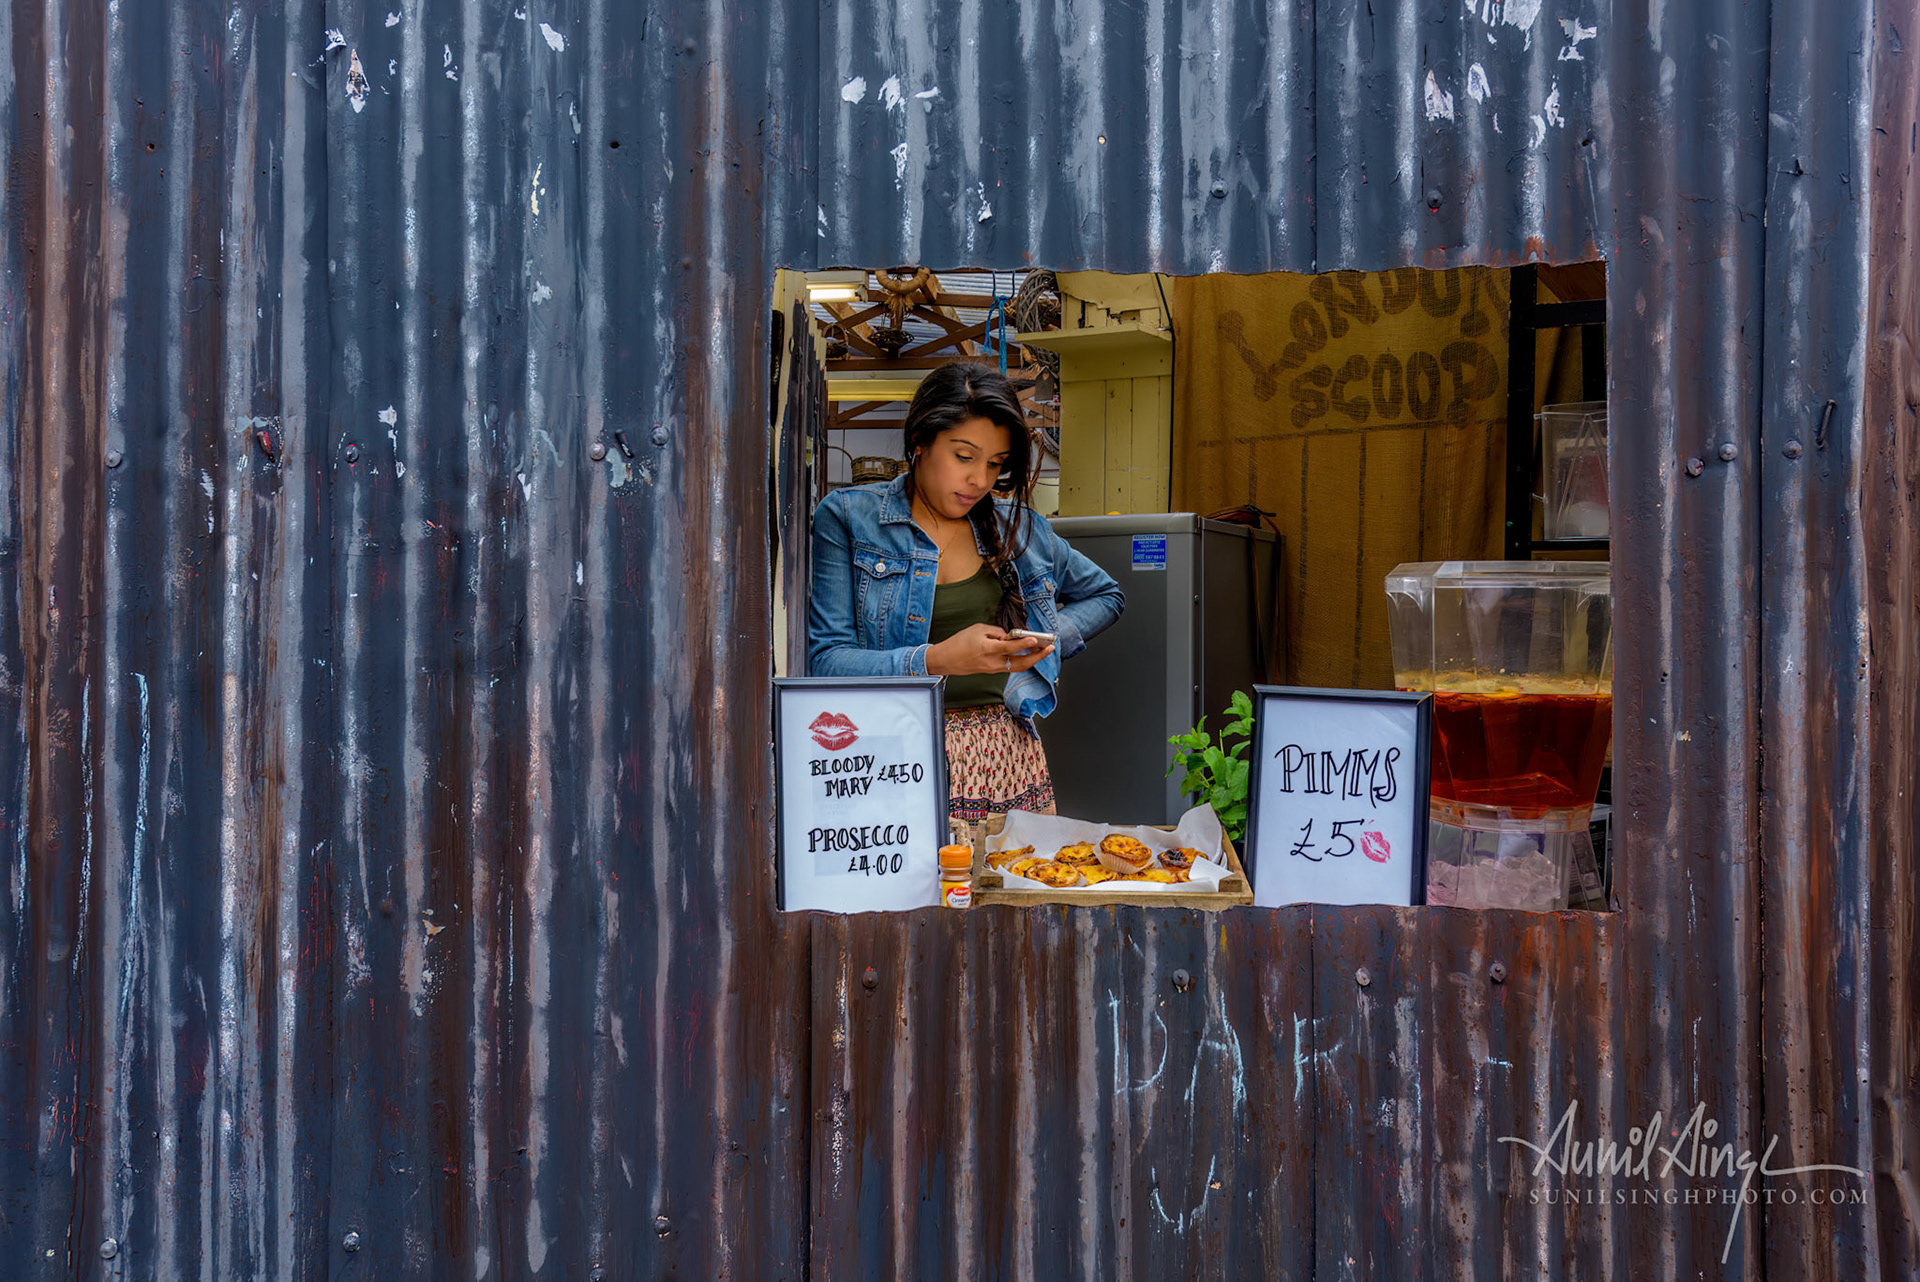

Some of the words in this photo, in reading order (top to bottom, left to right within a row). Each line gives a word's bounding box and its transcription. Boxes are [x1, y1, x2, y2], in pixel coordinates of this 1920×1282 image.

[1289, 340, 1499, 430] SCOOP
[808, 755, 875, 776] BLOODY
[824, 776, 873, 799] MARY
[877, 763, 924, 784] £4.50
[1274, 744, 1401, 809] PIMMS
[807, 824, 909, 853] PROSECCO
[1290, 818, 1365, 862] £5
[848, 853, 903, 877] £4.00
